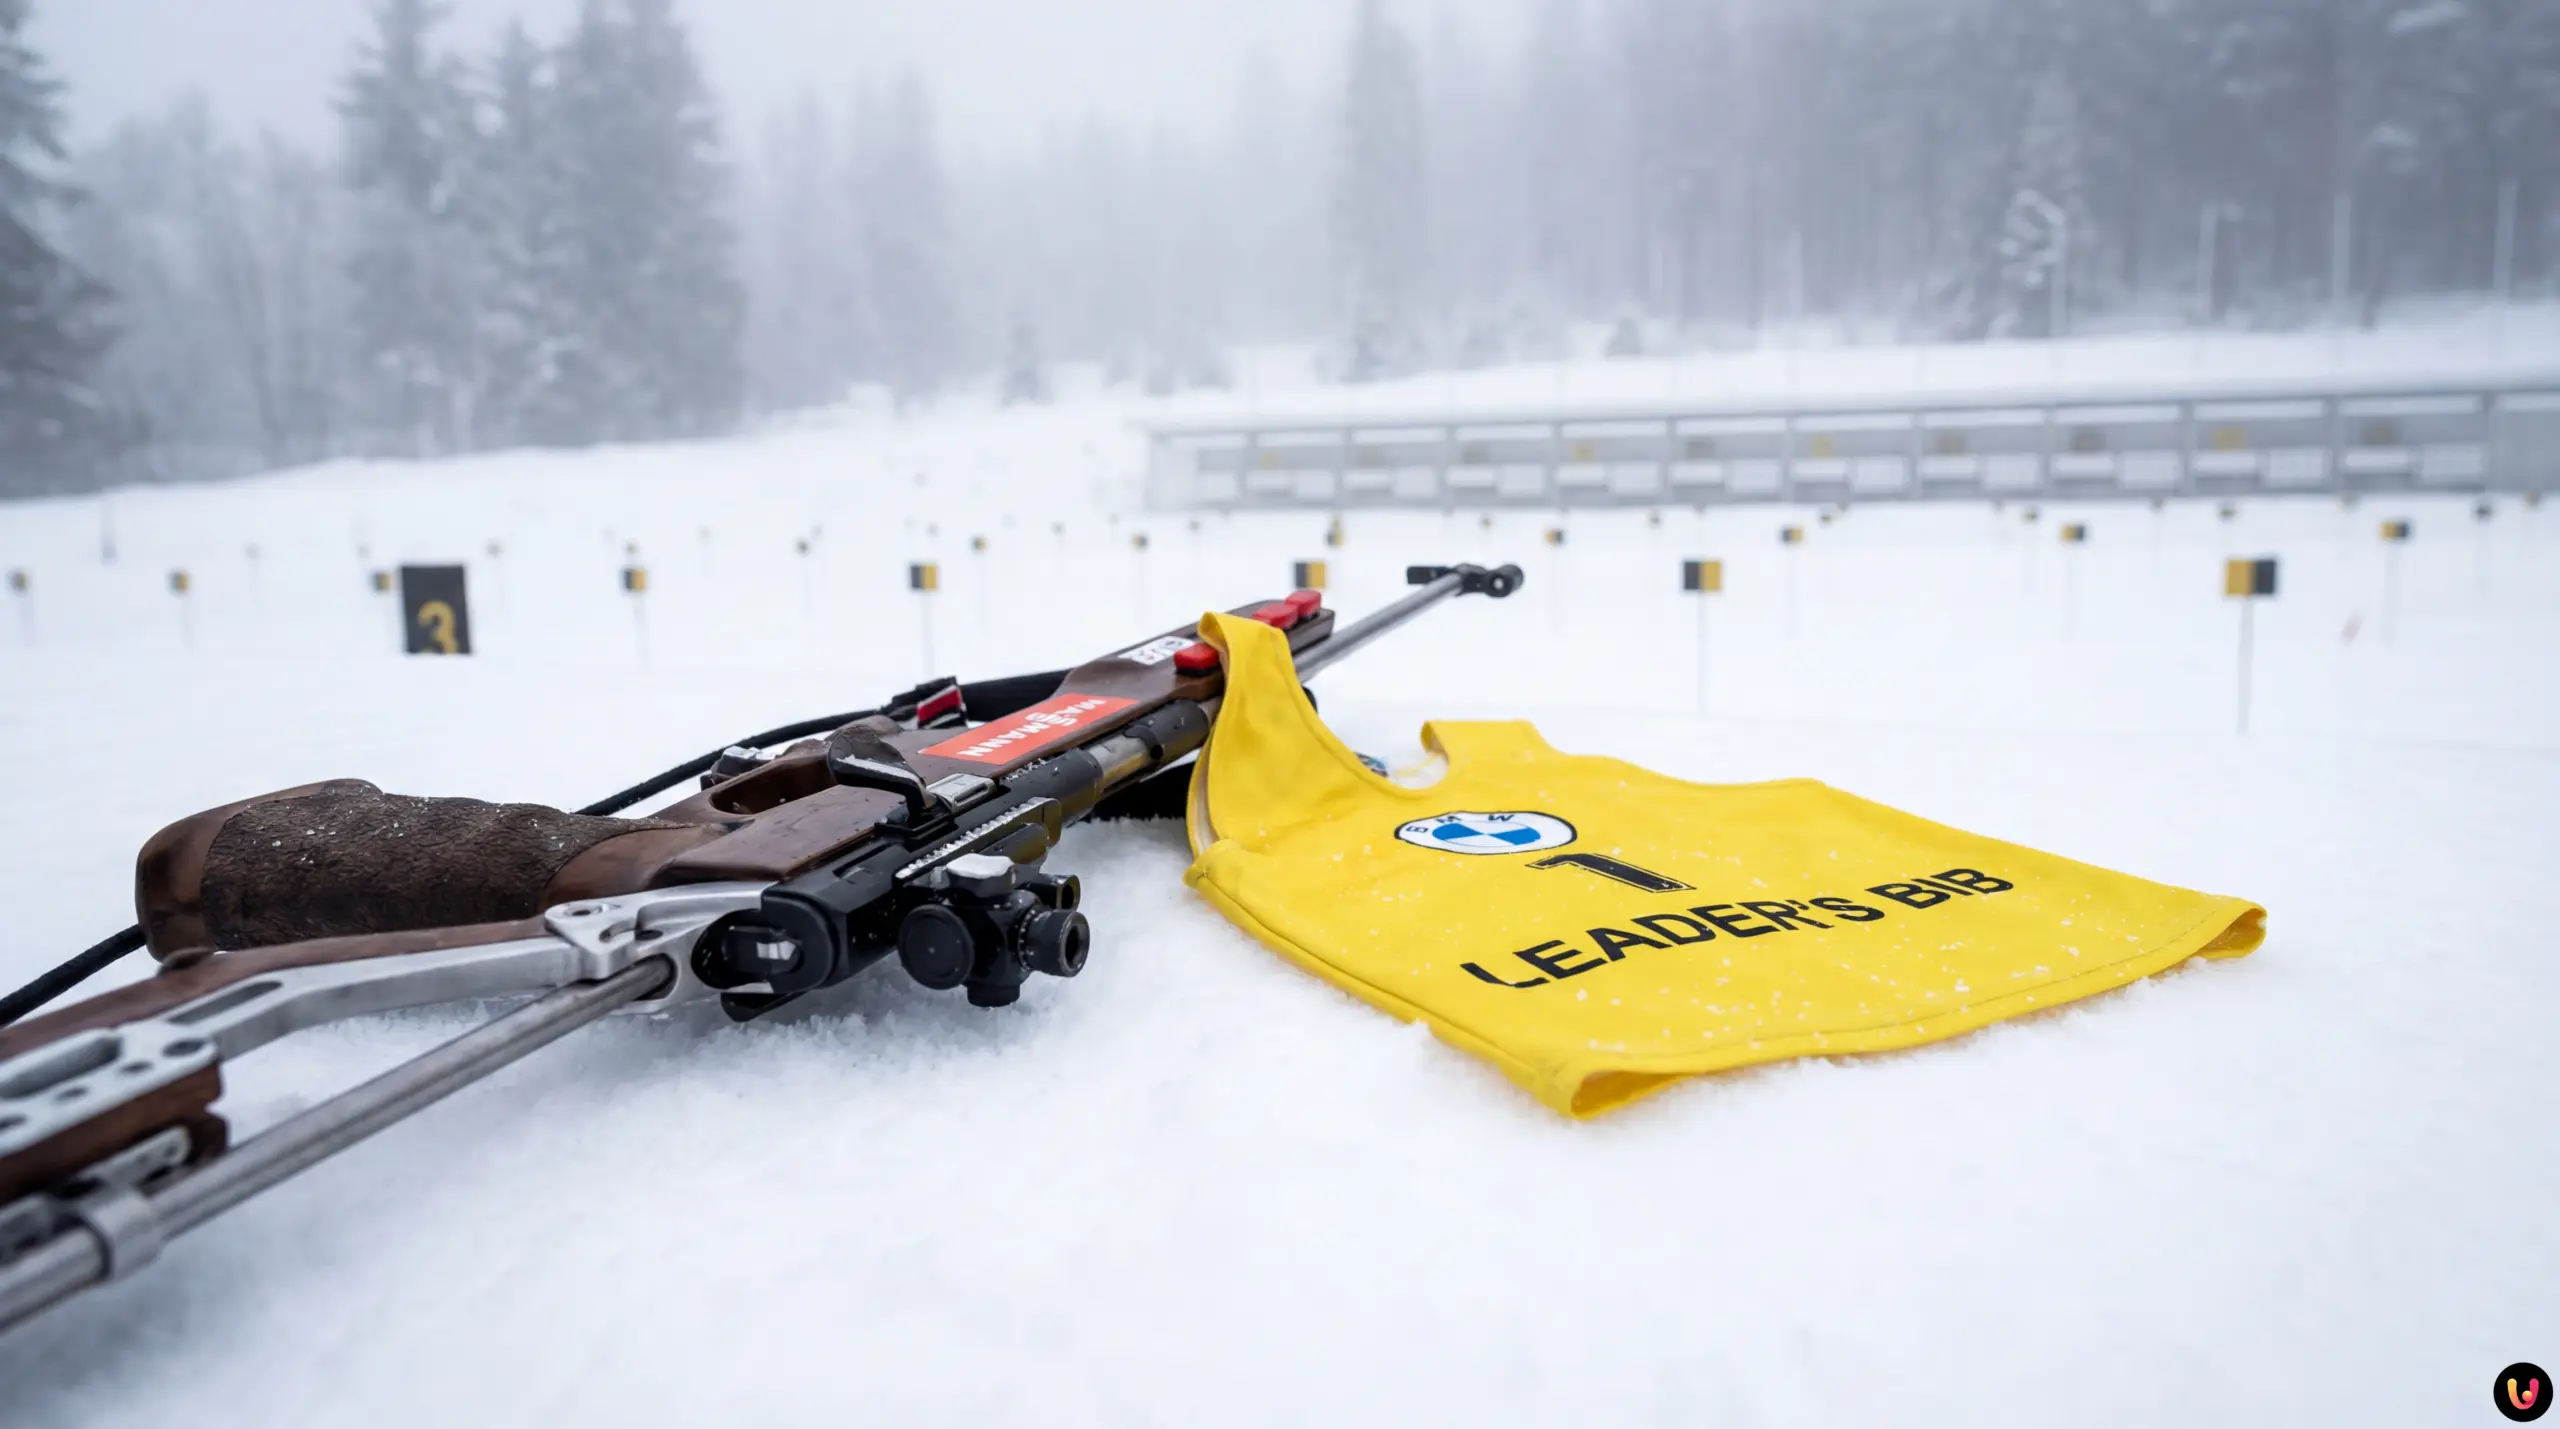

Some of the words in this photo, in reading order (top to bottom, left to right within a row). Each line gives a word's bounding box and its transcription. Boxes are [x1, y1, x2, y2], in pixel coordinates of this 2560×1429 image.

[1524, 853, 1697, 893] 1
[1460, 897, 1885, 989] LEADER'S
[1866, 867, 2014, 910] BIB
